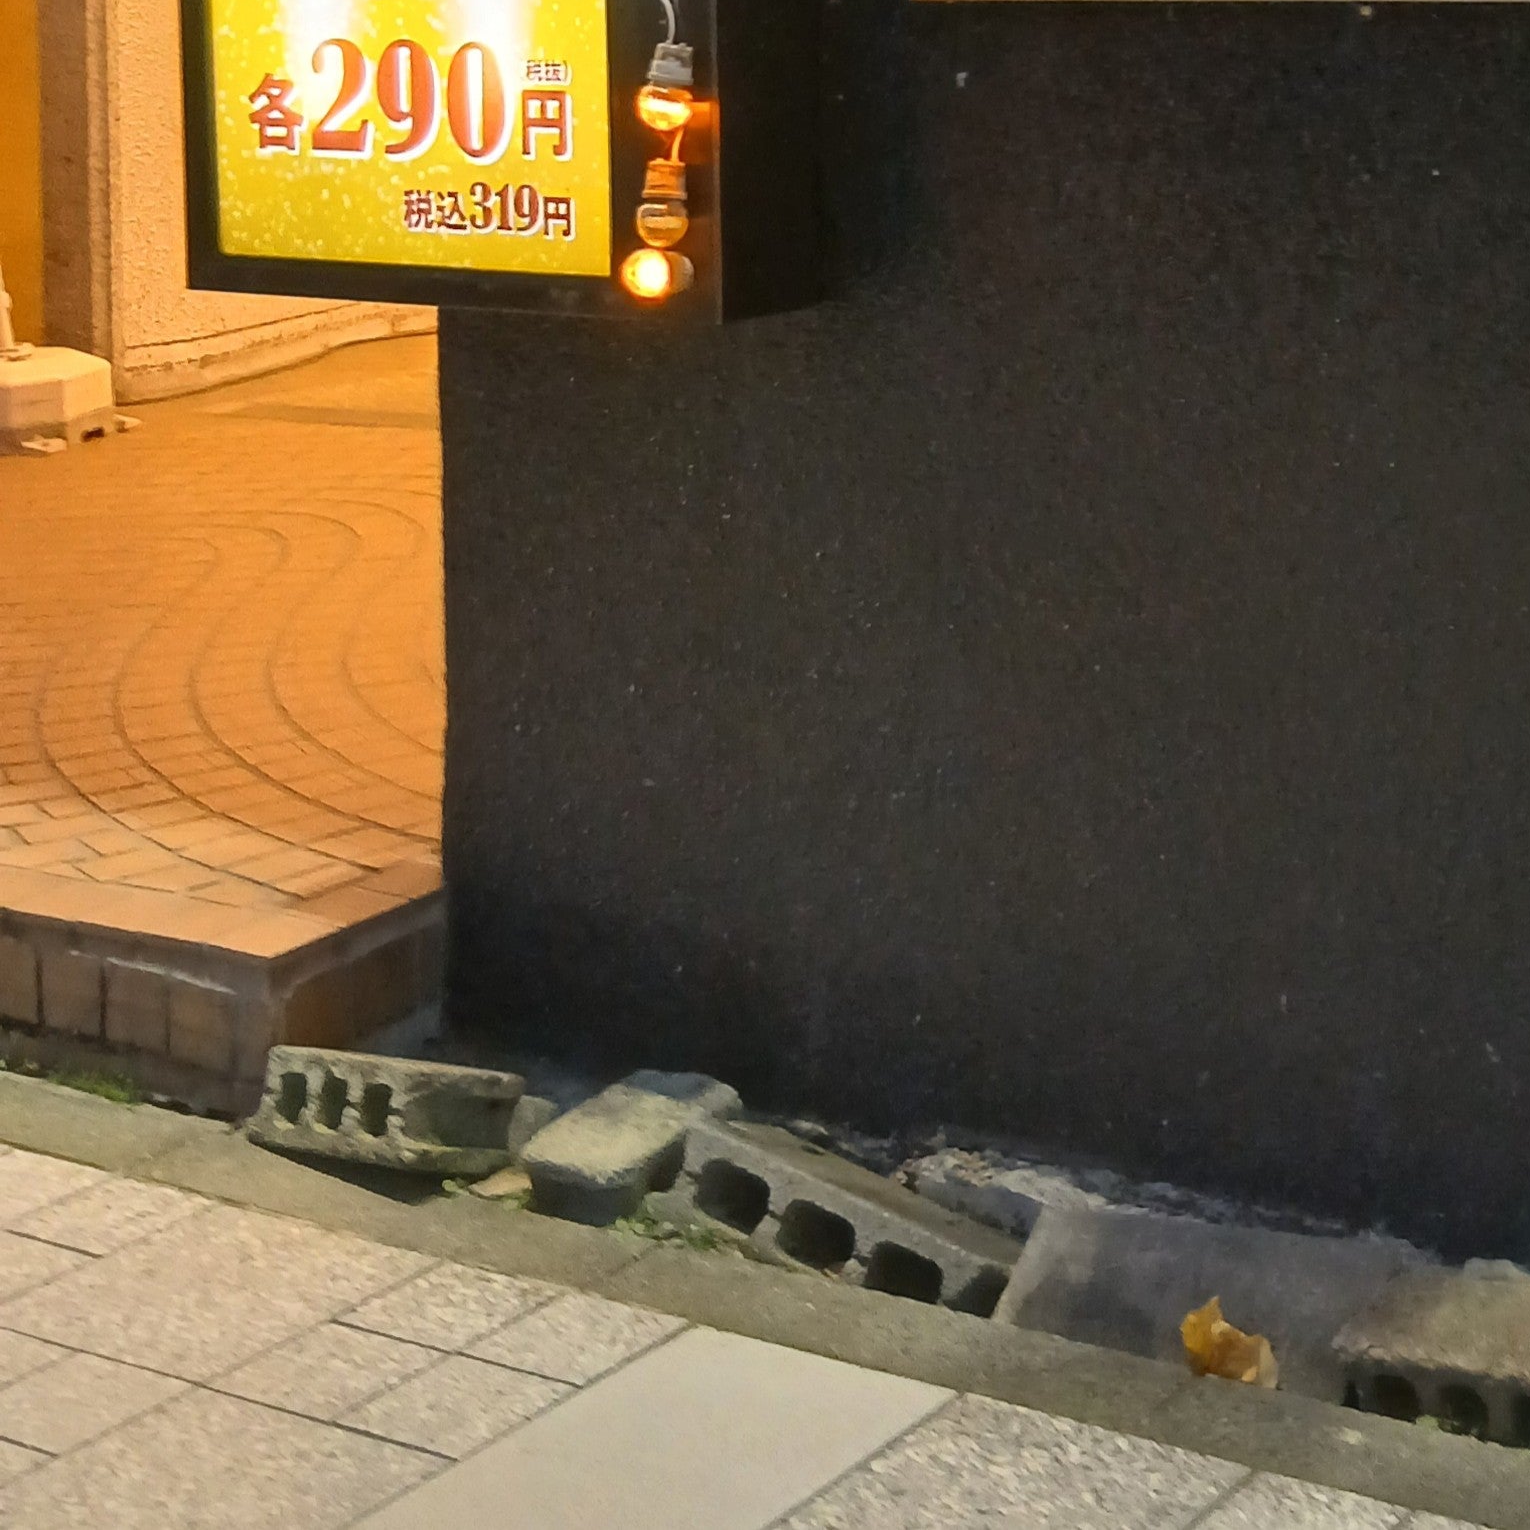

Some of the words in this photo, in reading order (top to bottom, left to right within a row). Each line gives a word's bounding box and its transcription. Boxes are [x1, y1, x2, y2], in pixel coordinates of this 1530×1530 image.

[249, 38, 571, 160] 各290円
[403, 181, 573, 238] 税込319円
